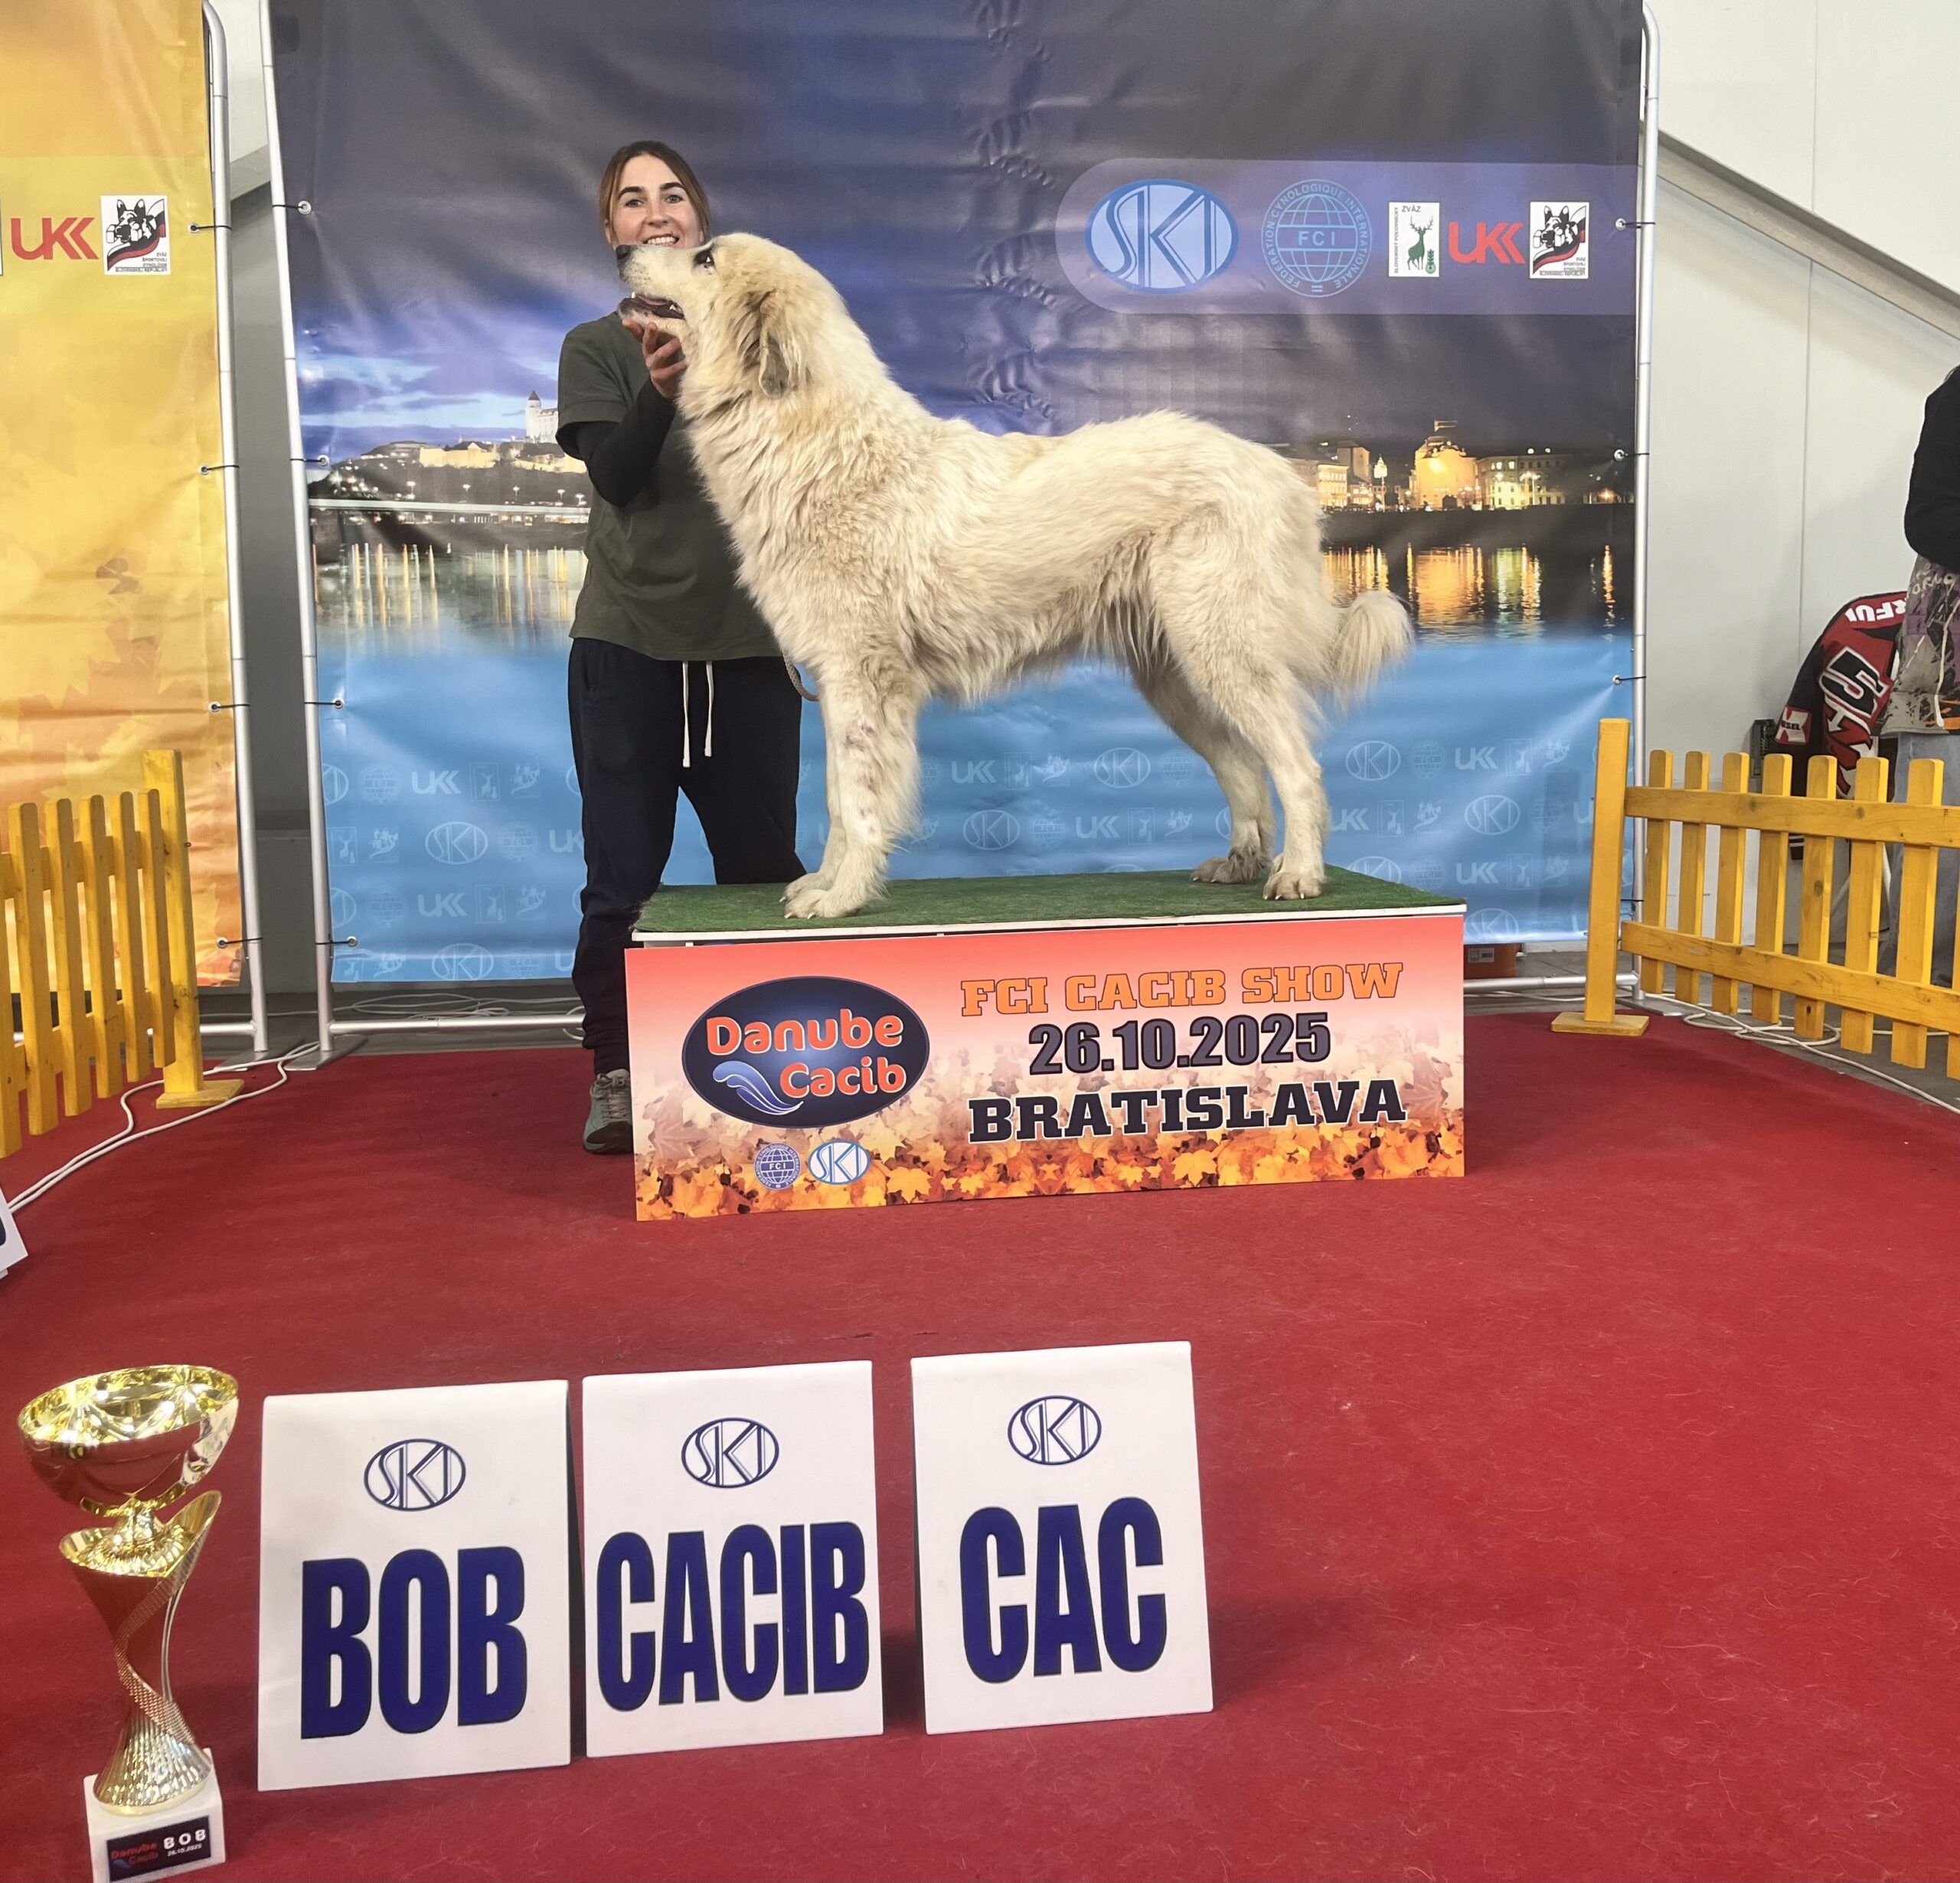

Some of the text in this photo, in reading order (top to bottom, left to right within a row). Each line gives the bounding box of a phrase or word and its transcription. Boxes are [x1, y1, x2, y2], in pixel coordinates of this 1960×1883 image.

[1266, 183, 1369, 289] FEDERATION CYNOLOGIQUE INTERNATIONALE
[1298, 230, 1337, 246] FCI
[961, 962, 1403, 1017] FCI CACIB SHOW
[706, 1008, 904, 1056] Danube
[1028, 1012, 1331, 1075] 26.10.2025
[779, 1056, 907, 1098] Cacib
[969, 1079, 1406, 1142] BRATISLAVA
[769, 1162, 786, 1170] FCI
[596, 1520, 869, 1712] CACIB
[959, 1496, 1168, 1684] CAC
[301, 1546, 528, 1740] BOB
